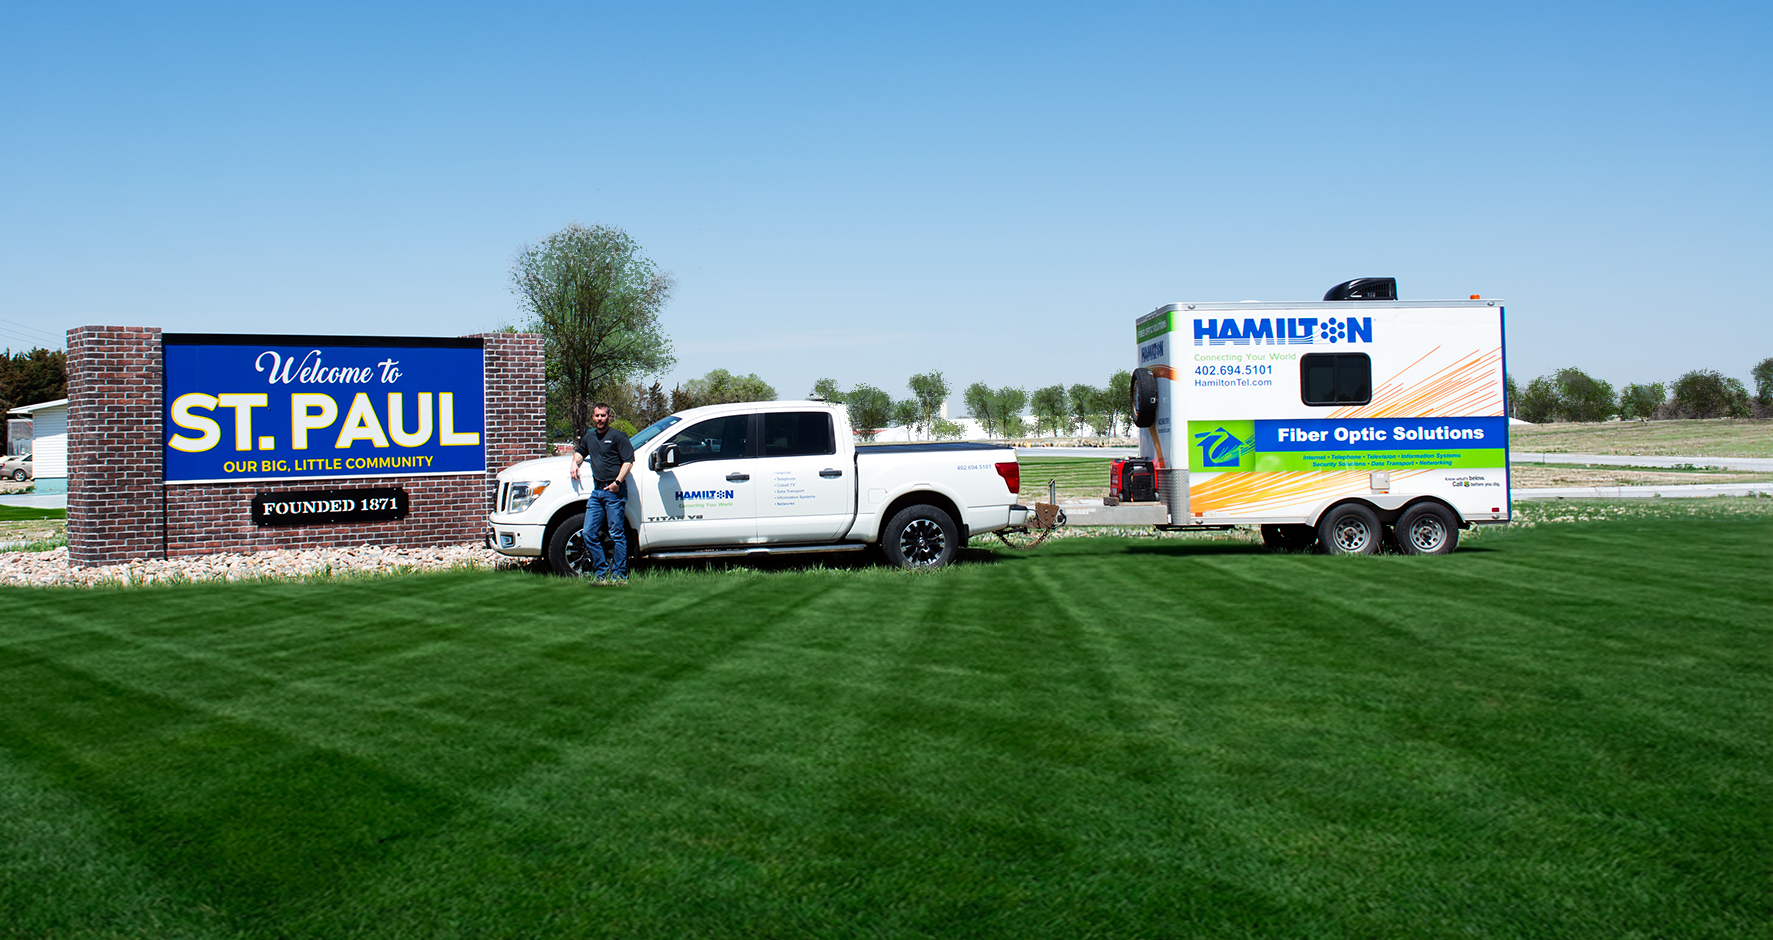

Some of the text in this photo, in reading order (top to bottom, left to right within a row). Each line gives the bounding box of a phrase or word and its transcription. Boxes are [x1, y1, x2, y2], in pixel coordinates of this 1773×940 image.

[1193, 317, 1372, 346] HAMILTON
[1194, 352, 1296, 362] Connecting Your World
[255, 350, 403, 384] Welcome to
[1194, 365, 1272, 376] 402.694.5101
[1194, 378, 1272, 386] HamiltonTel.com
[168, 392, 480, 453] ST. PAUL
[1278, 426, 1484, 444] Fiber Optic Solutions
[223, 456, 434, 473] OUR BIG, LITTLE COMMUNITY
[675, 490, 734, 500] HAMILTON
[262, 498, 398, 516] FOUNDED 1871
